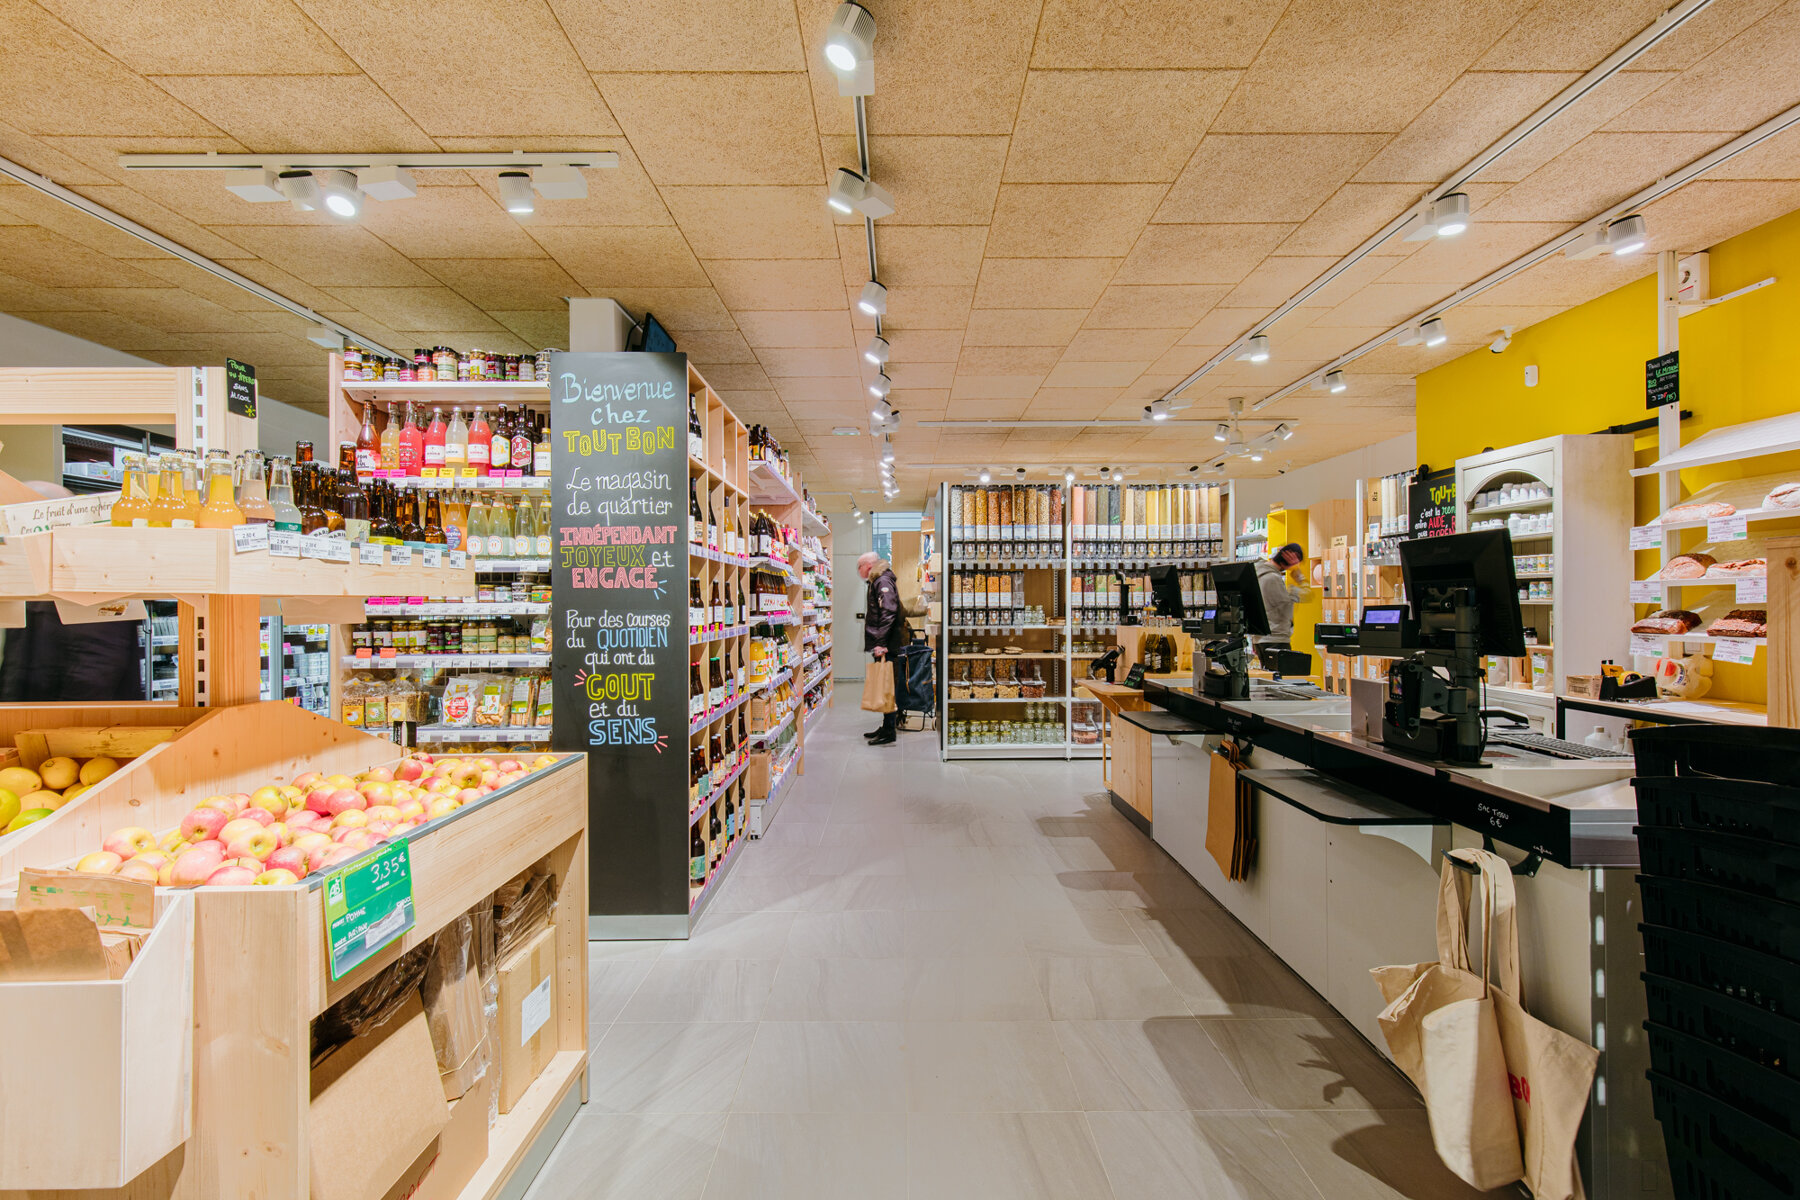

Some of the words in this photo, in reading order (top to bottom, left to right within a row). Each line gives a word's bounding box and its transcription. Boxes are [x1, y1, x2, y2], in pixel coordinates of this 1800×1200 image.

[560, 372, 676, 404] Bienvenue
[591, 403, 651, 425] chez
[563, 429, 622, 456] TOUT
[626, 426, 674, 455] BON
[566, 466, 592, 490] Le
[596, 470, 672, 500] magasin
[46, 506, 65, 520] fruit
[66, 503, 88, 515] d'une
[567, 491, 591, 516] de
[598, 496, 672, 526] quartier
[560, 523, 677, 546] INDÉPENDANT
[560, 545, 645, 567] JOYEUX
[652, 550, 675, 567] et
[572, 564, 658, 588] ENGAGÉ
[566, 610, 596, 628] Pour
[599, 610, 623, 627] des
[566, 630, 585, 648] du
[598, 627, 668, 651] QUOTIDIEN
[585, 650, 610, 674] qui
[613, 652, 636, 665] ont
[638, 648, 655, 665] du
[586, 673, 655, 700] GOUT
[589, 702, 610, 718] et
[617, 699, 639, 717] du
[589, 718, 658, 745] SENS
